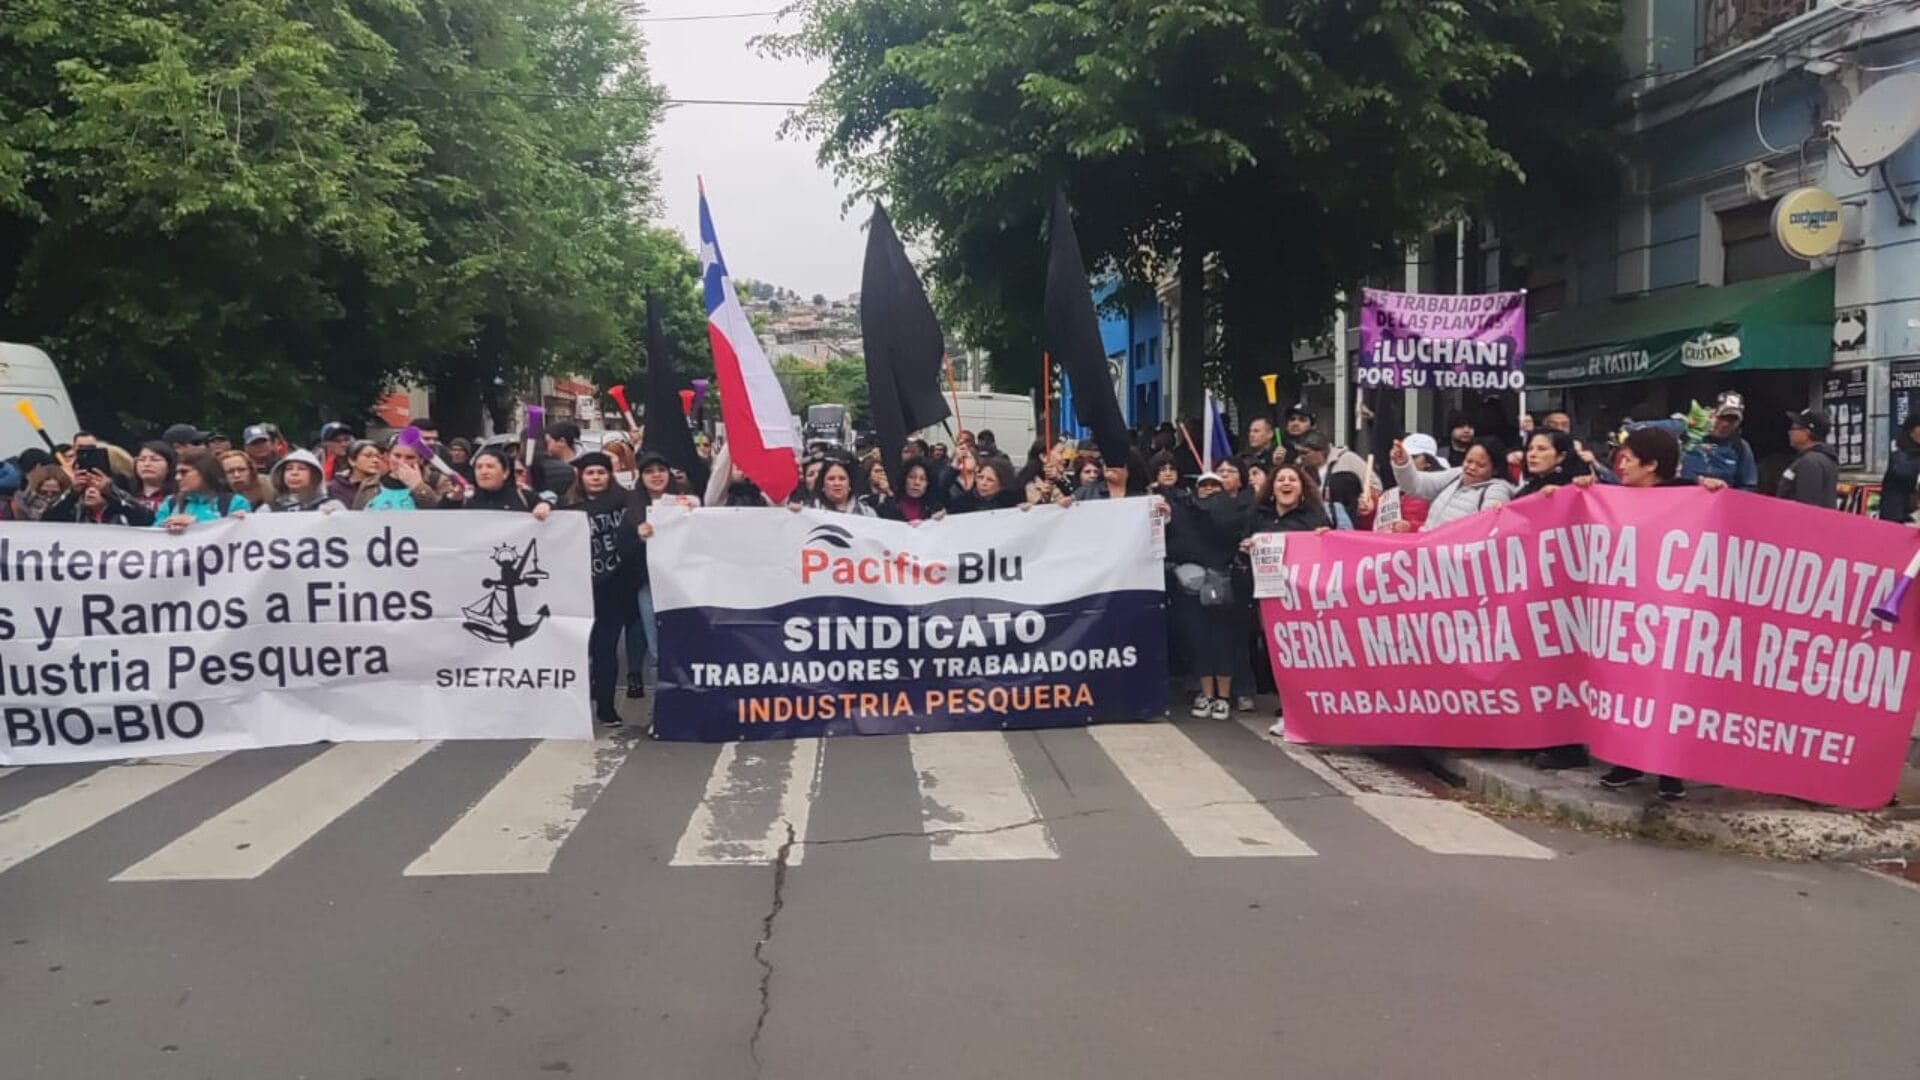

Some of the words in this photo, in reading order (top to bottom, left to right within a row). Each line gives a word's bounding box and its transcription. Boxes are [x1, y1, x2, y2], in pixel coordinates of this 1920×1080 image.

[1377, 310, 1395, 327] DE
[1400, 313, 1428, 329] LAS
[1432, 313, 1504, 331] PLANTAS
[1373, 337, 1508, 366] ¡LUCHAN!
[1358, 367, 1394, 385] POR
[1401, 369, 1426, 387] SU
[1433, 370, 1525, 389] TRABAJO
[0, 537, 349, 586] Interempresas
[367, 526, 419, 567] de
[801, 547, 945, 586] Pacific
[958, 549, 1022, 585] Blu
[1281, 564, 1302, 611] SI
[1309, 561, 1348, 610] LA
[1356, 528, 1528, 605] CESANTÍA
[1656, 529, 1896, 632] CANDIDATA
[34, 606, 62, 651] y
[82, 594, 248, 637] Ramos
[266, 592, 290, 623] a
[307, 581, 433, 623] Fines
[783, 610, 1046, 653] SINDICATO
[0, 649, 150, 697] ustria
[169, 645, 389, 687] Pesquera
[691, 659, 900, 687] TRABAJADORES
[909, 658, 925, 679] Y
[931, 645, 1138, 677] TRABAJADORAS
[1273, 610, 1356, 669] SERÍA
[1357, 597, 1521, 667] MAYORÍA
[1753, 630, 1911, 713] REGIÓN
[436, 667, 576, 689] SIETRAFIP
[3, 701, 204, 748] BIO-BIO
[738, 693, 913, 724] INDUSTRIA
[925, 682, 1093, 716] PESQUERA
[1305, 687, 1520, 716] TRABAJADORES
[1668, 703, 1856, 765] PRESENTE!
